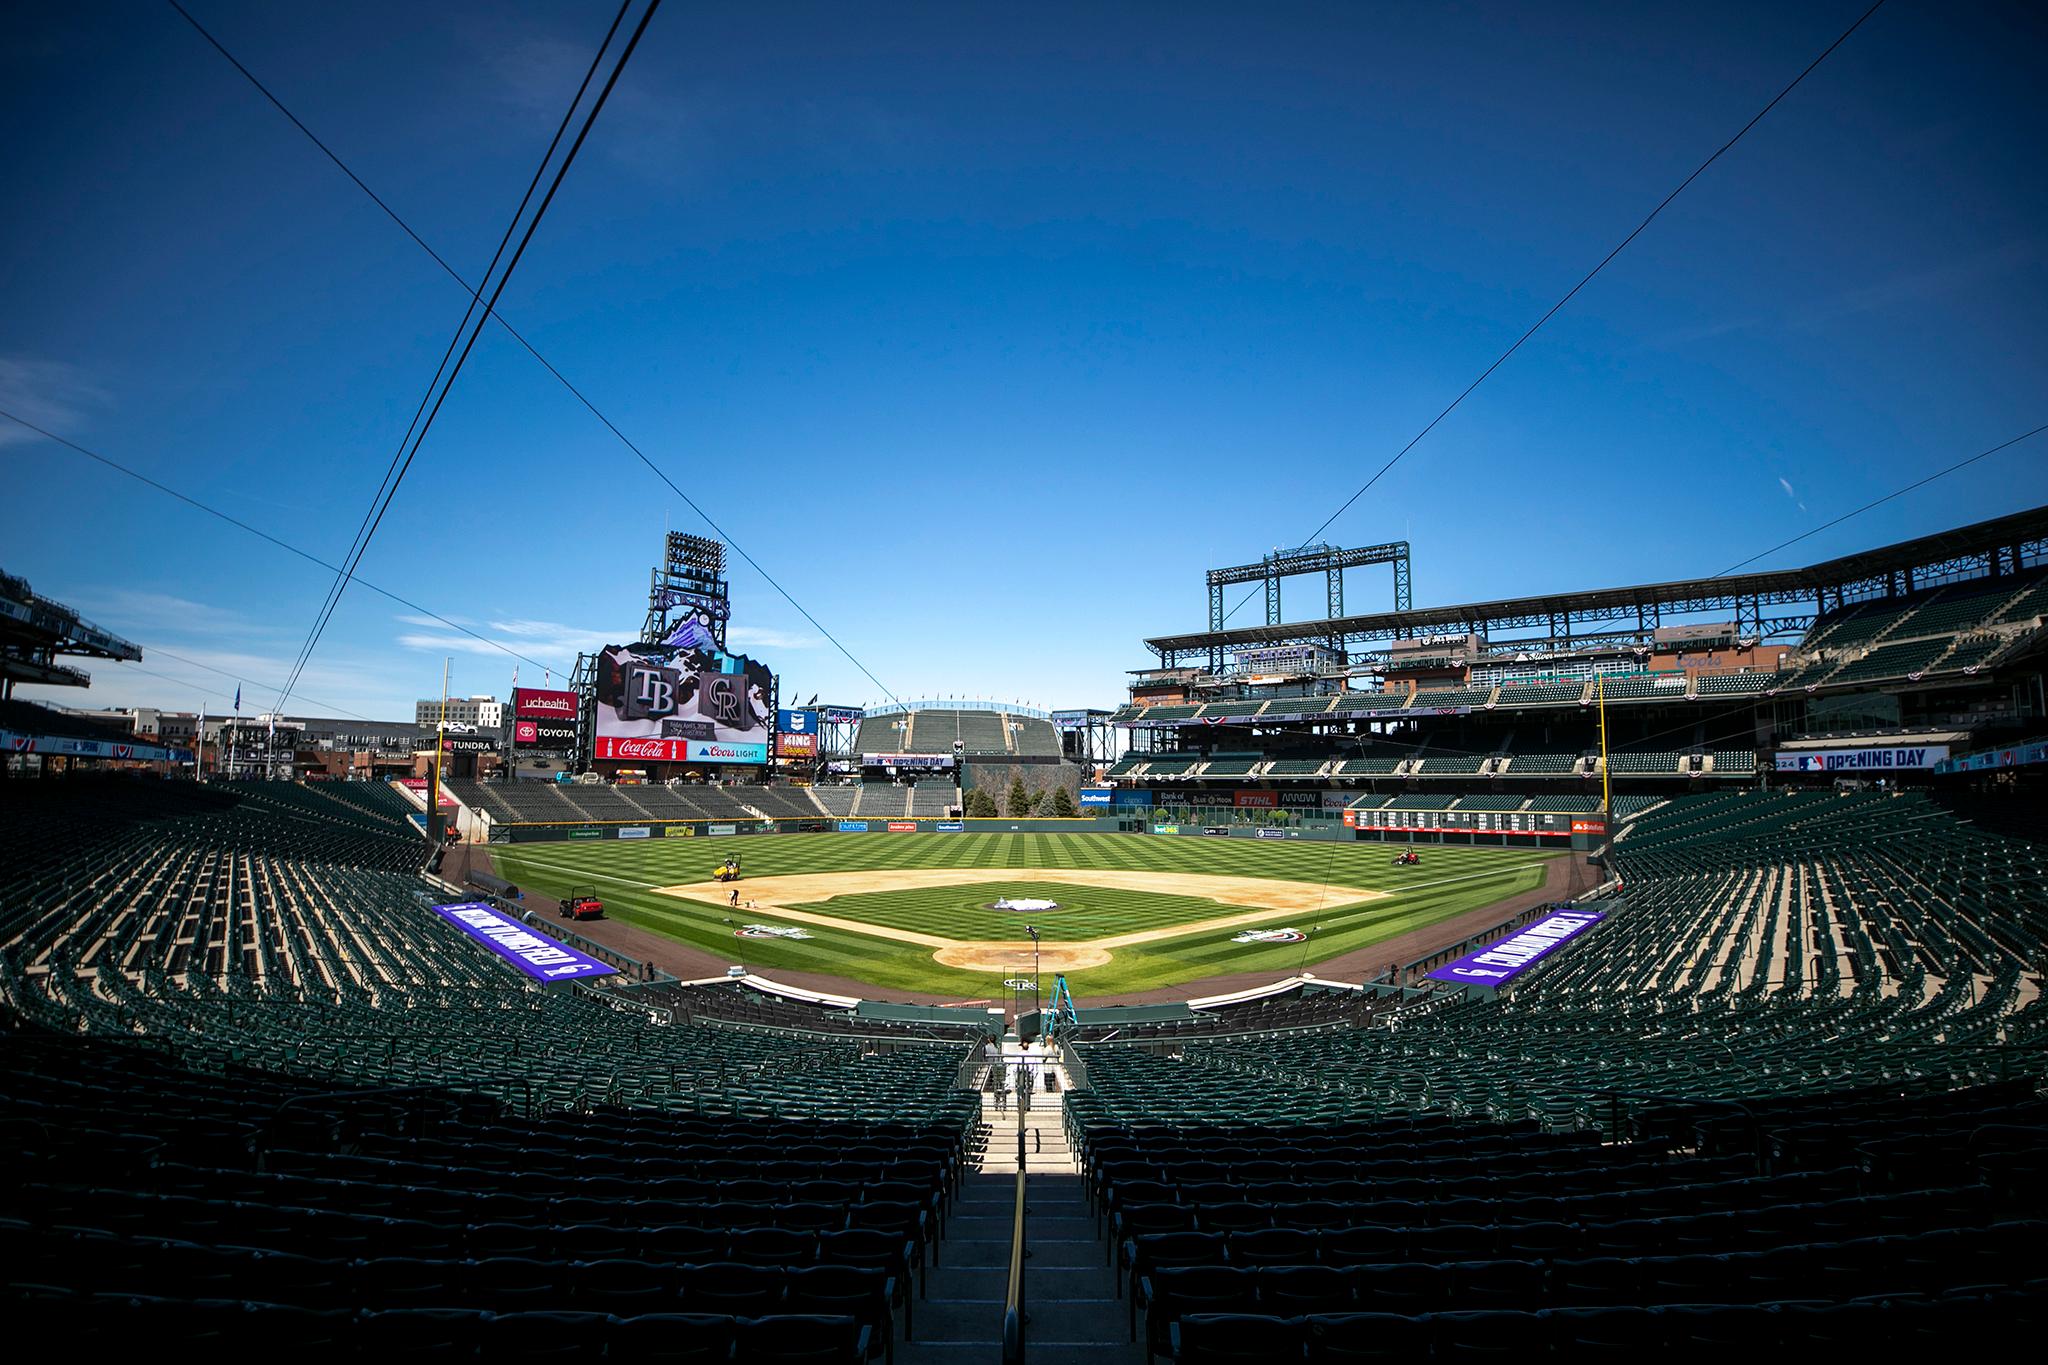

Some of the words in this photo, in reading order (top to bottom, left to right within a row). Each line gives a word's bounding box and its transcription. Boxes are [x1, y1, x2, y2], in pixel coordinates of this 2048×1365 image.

[525, 697, 570, 710] uchealth
[829, 709, 852, 719] OPENING
[1301, 711, 1336, 721] OPENING
[1338, 710, 1353, 719] DAY
[537, 728, 575, 738] TOYOTA
[453, 740, 491, 750] TUNDRA
[783, 735, 811, 747] KING
[619, 740, 666, 758] Coca-Cola
[710, 745, 735, 757] Coors
[736, 750, 758, 758] LIGHT
[893, 757, 927, 767] OPENING
[929, 757, 945, 767] DAY
[1827, 751, 1893, 770] OPENING
[1896, 749, 1926, 767] DAY
[1160, 791, 1176, 800] Bank
[1177, 791, 1185, 800] of
[1239, 796, 1273, 805] STIHL
